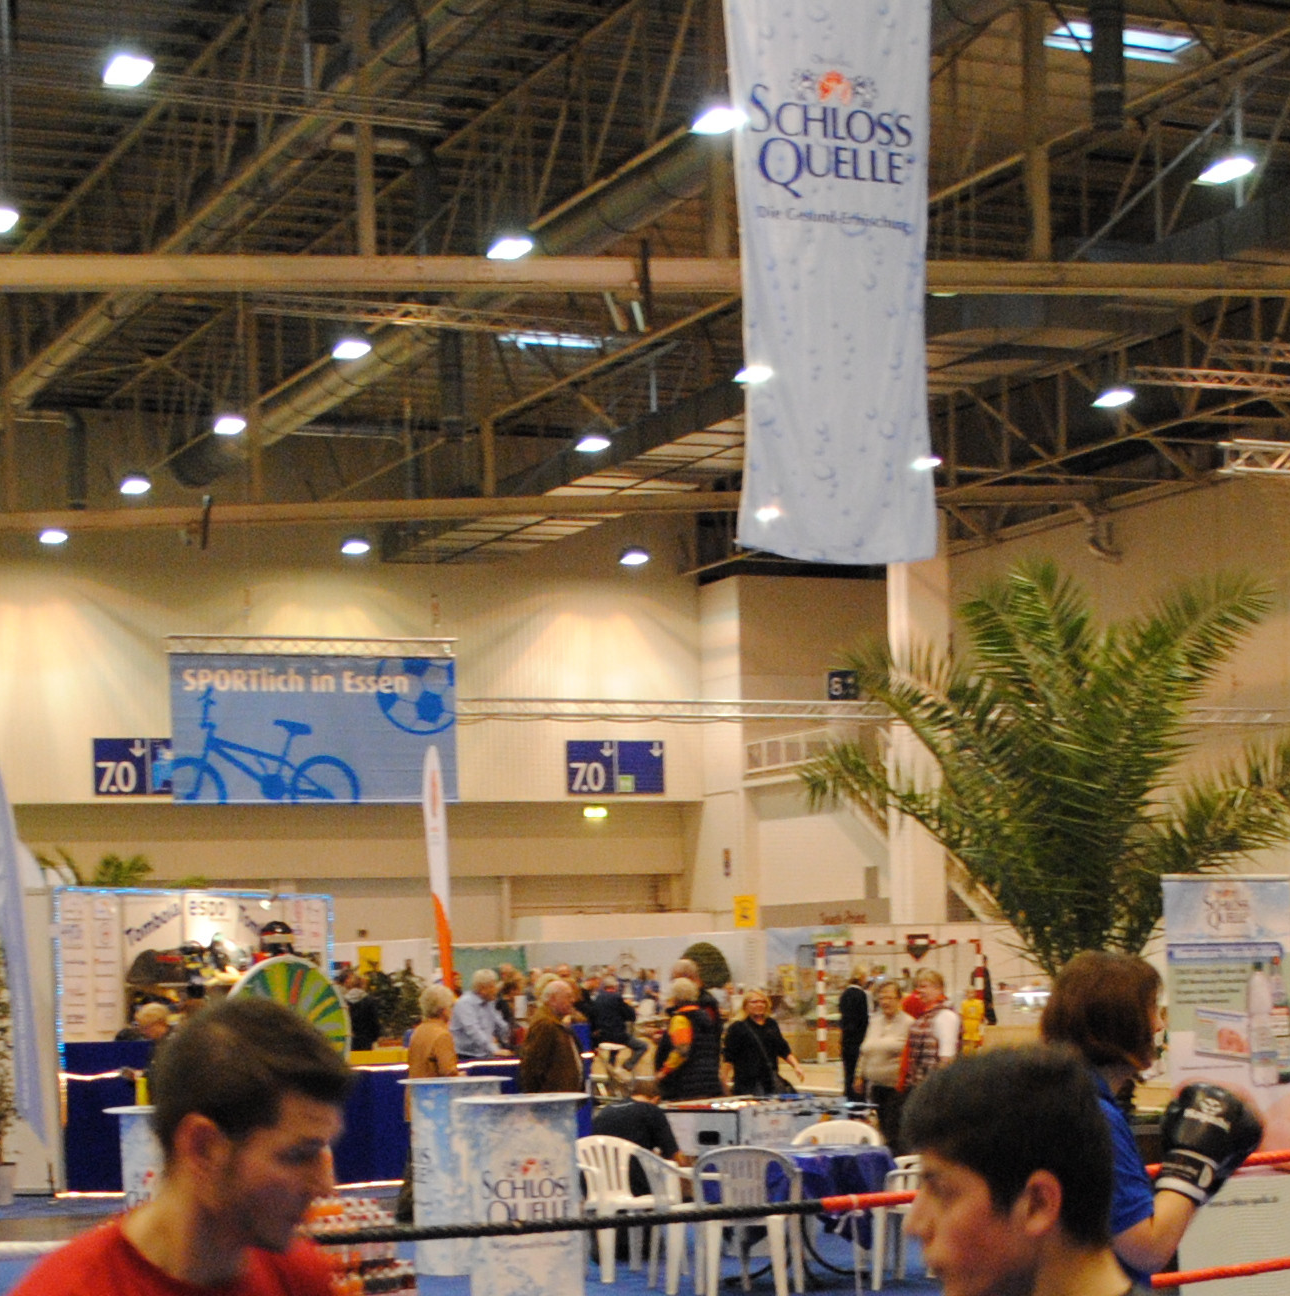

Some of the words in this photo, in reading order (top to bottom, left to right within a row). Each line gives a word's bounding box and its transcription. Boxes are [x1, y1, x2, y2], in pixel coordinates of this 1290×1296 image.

[749, 84, 913, 147] SCHLOSS
[759, 137, 903, 198] QUELLE
[182, 667, 305, 693] SPORTlich
[312, 668, 336, 693] in
[342, 670, 409, 693] Essen
[96, 761, 137, 793] 7.0
[569, 762, 606, 792] 7.0
